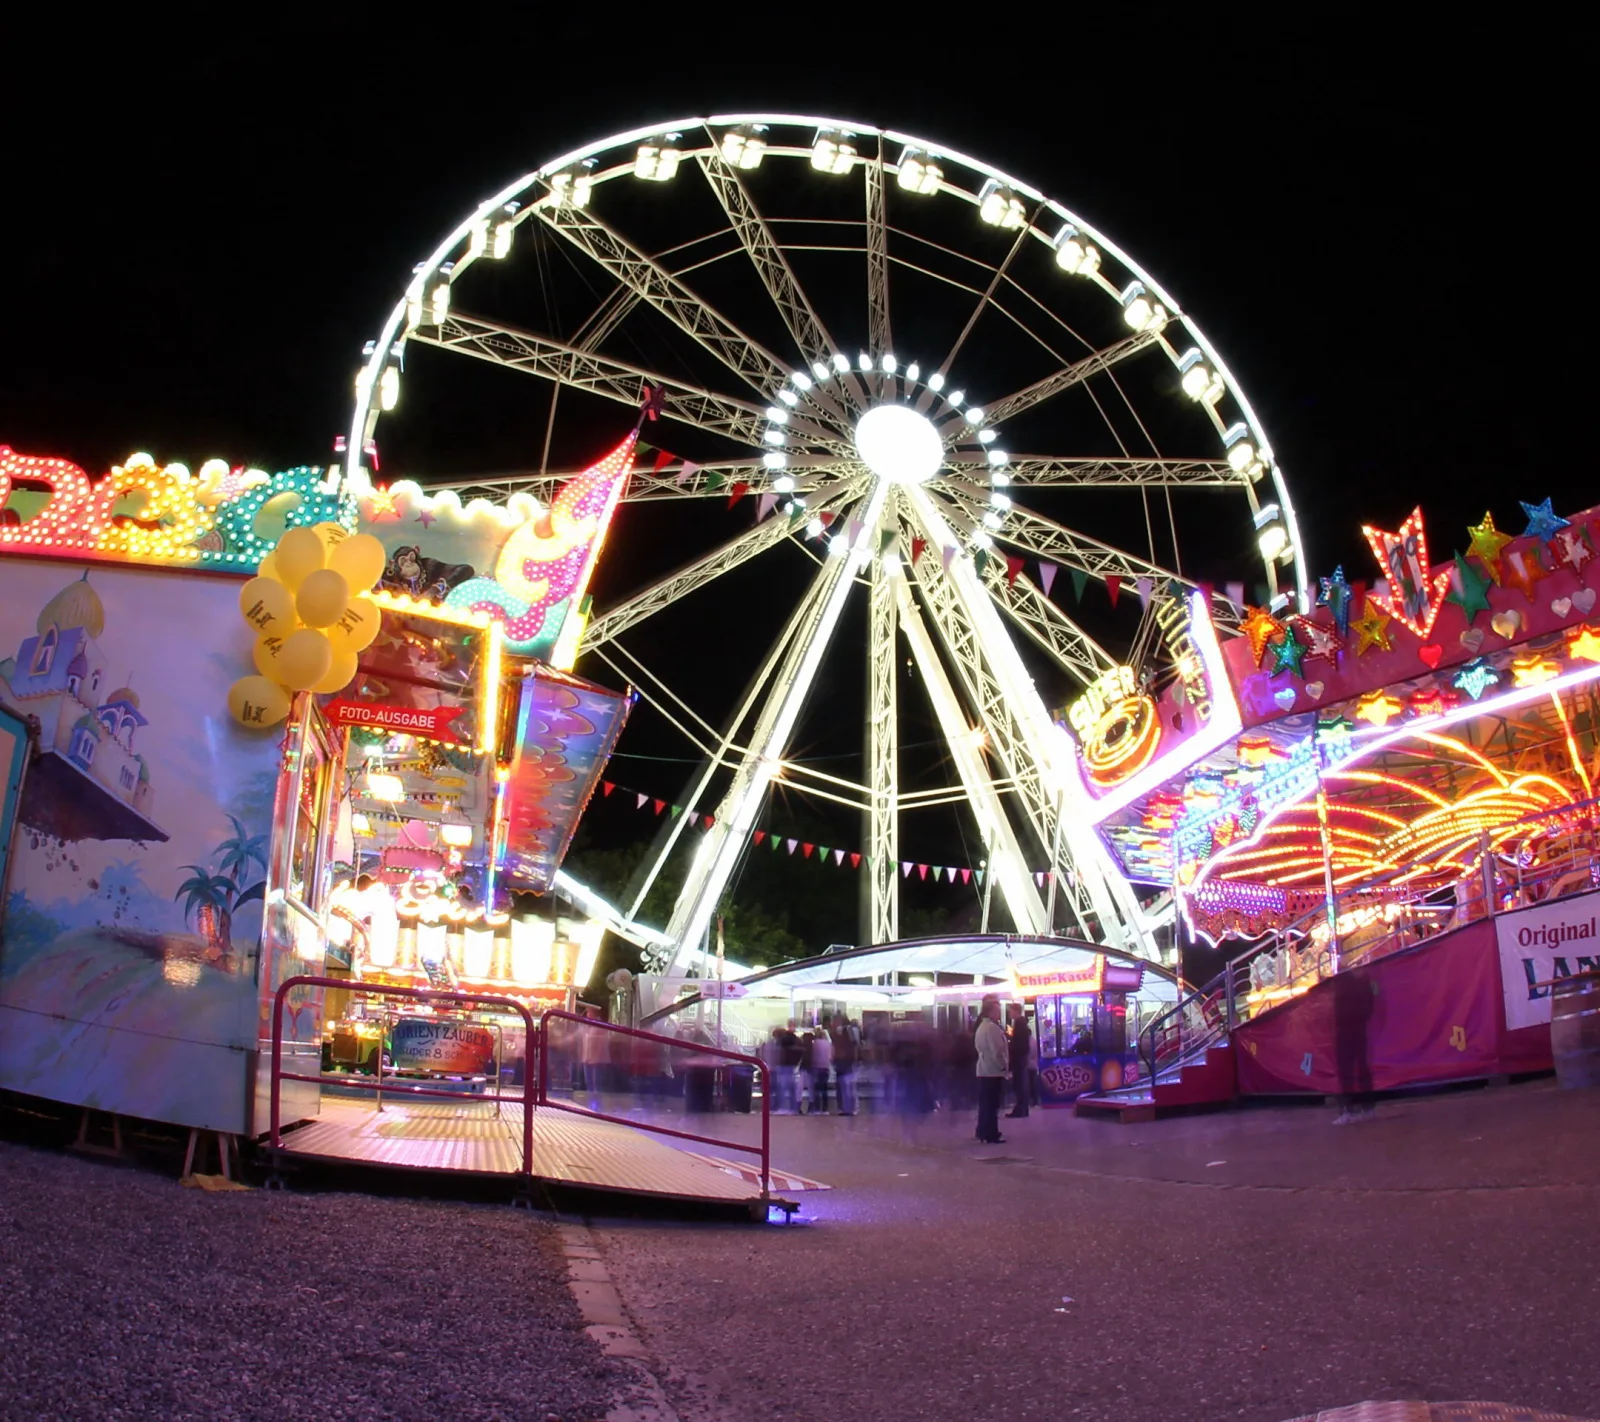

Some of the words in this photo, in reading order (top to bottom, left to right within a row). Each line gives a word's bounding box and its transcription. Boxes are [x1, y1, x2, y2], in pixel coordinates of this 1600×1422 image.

[339, 706, 436, 728] FOTO-AUSGABE
[1518, 917, 1596, 948] Original
[1019, 972, 1095, 986] Chip-Kasse
[396, 1023, 440, 1040] ORIENT
[443, 1026, 489, 1047] ZAUBER
[433, 1047, 442, 1059] 8
